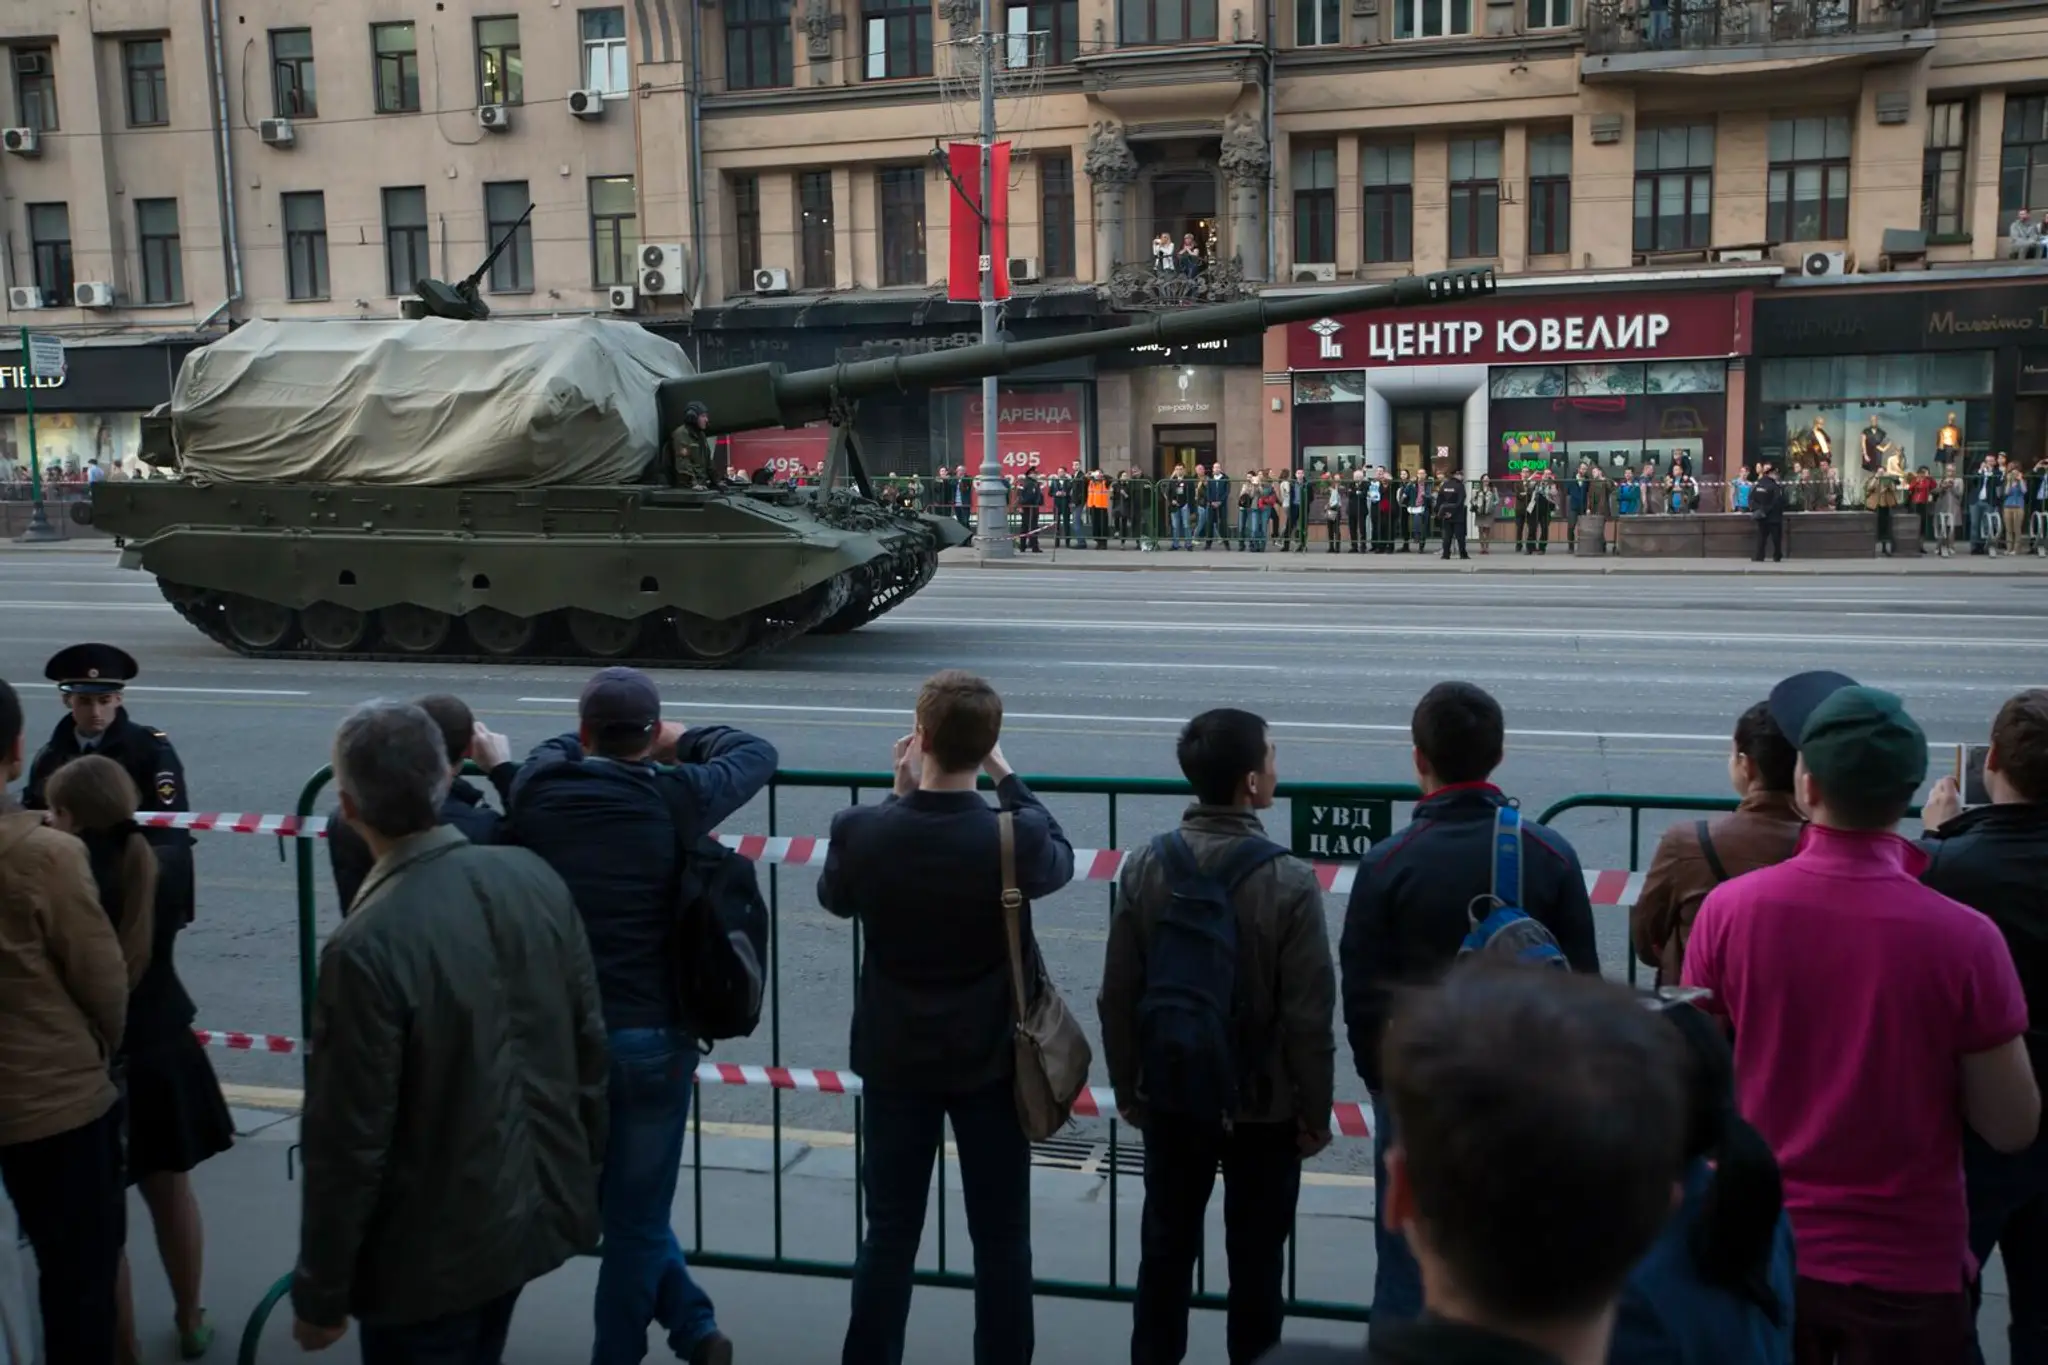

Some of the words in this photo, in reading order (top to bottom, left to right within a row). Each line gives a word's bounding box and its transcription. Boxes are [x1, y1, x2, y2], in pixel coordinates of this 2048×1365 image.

[1928, 310, 2033, 334] Massimo
[1368, 321, 1484, 361] ЦЕНТР
[1496, 313, 1671, 352] ЮВЕЛИР
[1000, 407, 1072, 423] АРЕНДА
[1196, 401, 1210, 411] bar
[764, 457, 800, 473] 495
[1003, 451, 1041, 467] 495
[1311, 806, 1371, 829] УВД
[1309, 833, 1372, 856] ЦАО
